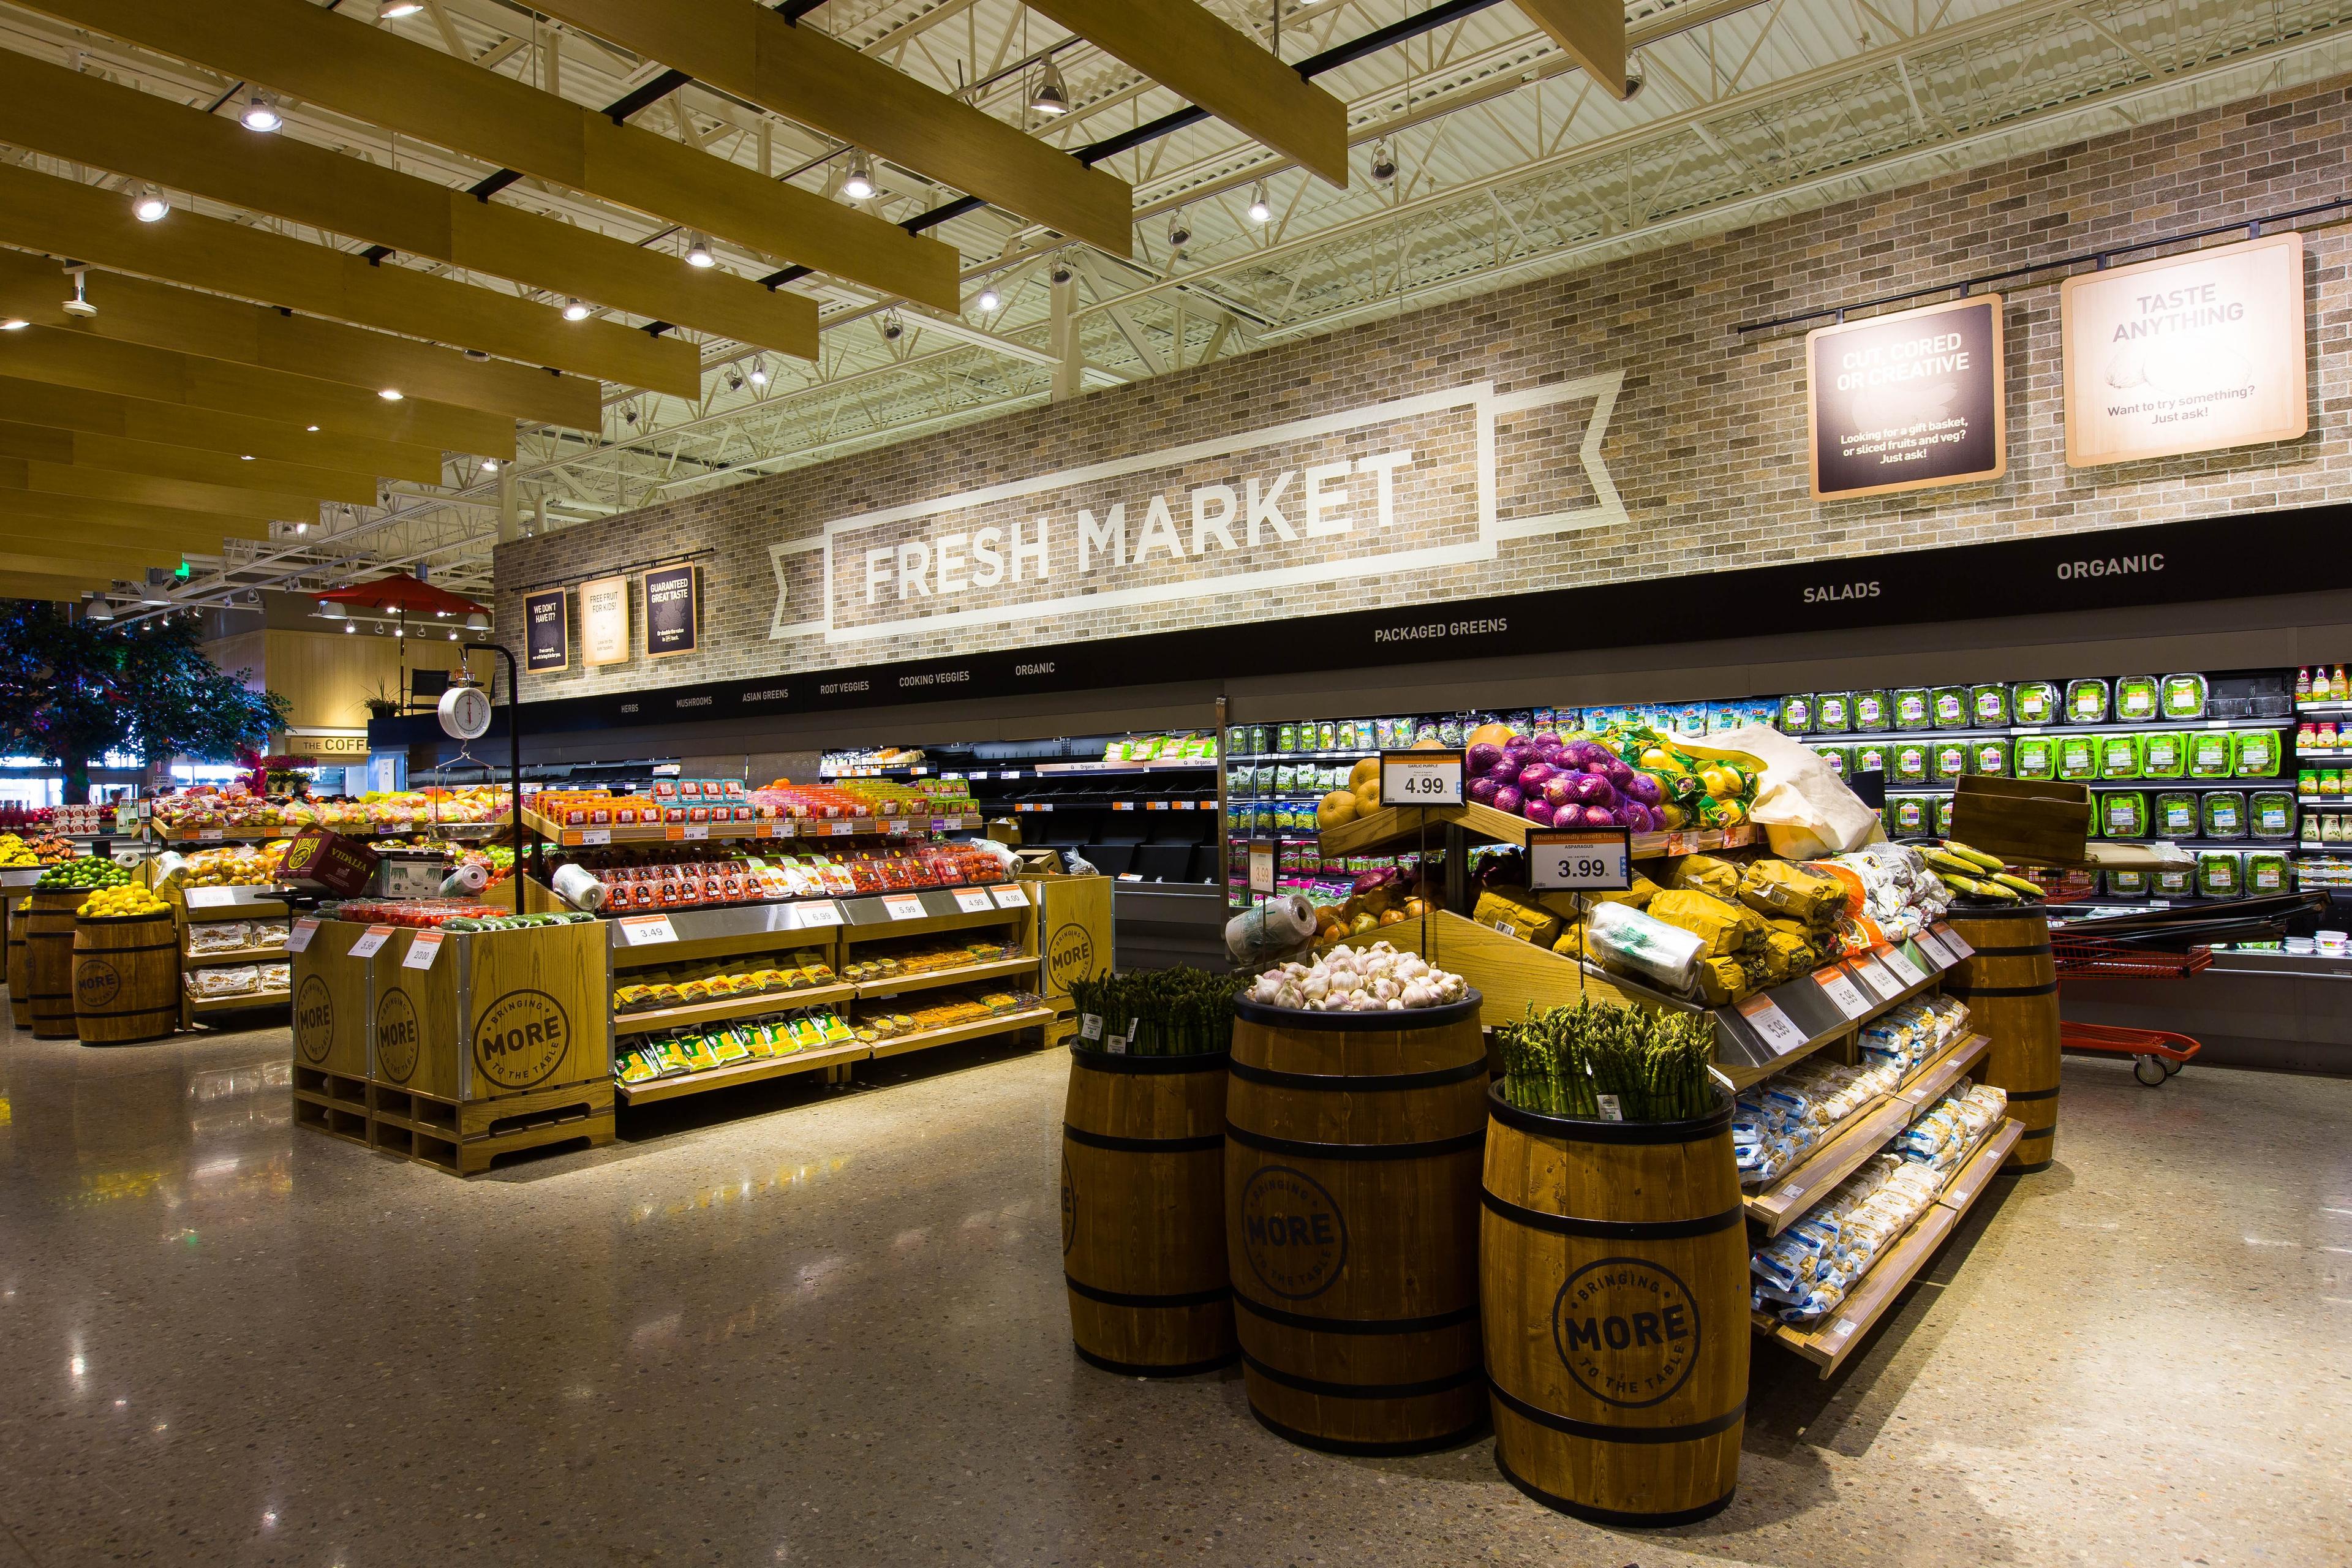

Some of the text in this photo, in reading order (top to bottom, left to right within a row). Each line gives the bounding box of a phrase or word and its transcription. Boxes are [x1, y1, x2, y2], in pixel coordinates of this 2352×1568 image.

[2136, 283, 2216, 314] TASTE
[2113, 302, 2244, 343] ANYTHING
[1890, 333, 1962, 361] CORED
[1837, 352, 1970, 391] OR CREATIVE
[2108, 385, 2255, 417] Want to try something?
[2152, 407, 2209, 424] Just ask!
[1841, 430, 1882, 445] Looking
[1883, 427, 1898, 438] for
[1909, 423, 1927, 436] gift
[1928, 416, 1969, 431] basket,
[1843, 429, 1967, 457] or sliced fruits and veg?
[1880, 448, 1928, 464] Just ask!
[866, 449, 1412, 605] FRESH MARKET
[2057, 553, 2165, 579] ORGANIC
[650, 578, 688, 594] GUARANTEED
[1803, 581, 1881, 603] SALADS
[590, 591, 618, 604] FREE FRUIT
[651, 589, 688, 603] GREAT TASTE
[534, 602, 556, 614] WE DON'T
[592, 601, 617, 613] FOR KIDS!
[535, 613, 549, 624] HAVE
[1374, 617, 1507, 643] PACKAGED GREENS
[1015, 662, 1055, 676] ORGANIC
[820, 680, 869, 695] ROOT VEGGIES
[899, 671, 970, 687] COOKING VEGGIES
[676, 696, 712, 708] MUSHROOMS
[742, 689, 789, 702] ASIAN GREENS
[621, 704, 639, 713] HERBS
[1405, 778, 1443, 794] 4.99
[293, 838, 321, 853] VIDALIA
[331, 847, 368, 872] VIDALIA
[1558, 859, 1605, 878] 3.99
[1256, 867, 1268, 883] 3.99
[812, 912, 831, 921] 6.99
[640, 928, 663, 937] 3.49
[1055, 930, 1080, 946] BRINGING
[360, 941, 376, 951] 5.99
[1052, 942, 1090, 971] MORE
[78, 973, 116, 990] MORE
[1057, 973, 1063, 981] TO
[303, 982, 323, 1000] BRINGING
[1839, 989, 1858, 1006] 5.99
[382, 997, 407, 1016] BRINGING
[491, 999, 543, 1025] BRINGING
[300, 1004, 331, 1031] MORE
[380, 1019, 415, 1049] MORE
[482, 1015, 562, 1061] MORE
[1767, 1019, 1790, 1038] 5.99
[309, 1044, 318, 1055] THE
[318, 1028, 330, 1053] TABLE
[383, 1047, 415, 1074] TO THE TABLE
[492, 1042, 559, 1079] TO THE TABLE
[1253, 1178, 1309, 1201] BRINGING
[1246, 1213, 1335, 1246] MORE
[1270, 1268, 1294, 1286] THE
[1299, 1250, 1332, 1285] TABLE
[1577, 1272, 1660, 1302] BRINGING
[1565, 1303, 1689, 1351] MORE
[1579, 1344, 1685, 1393] TO THE TABLE
